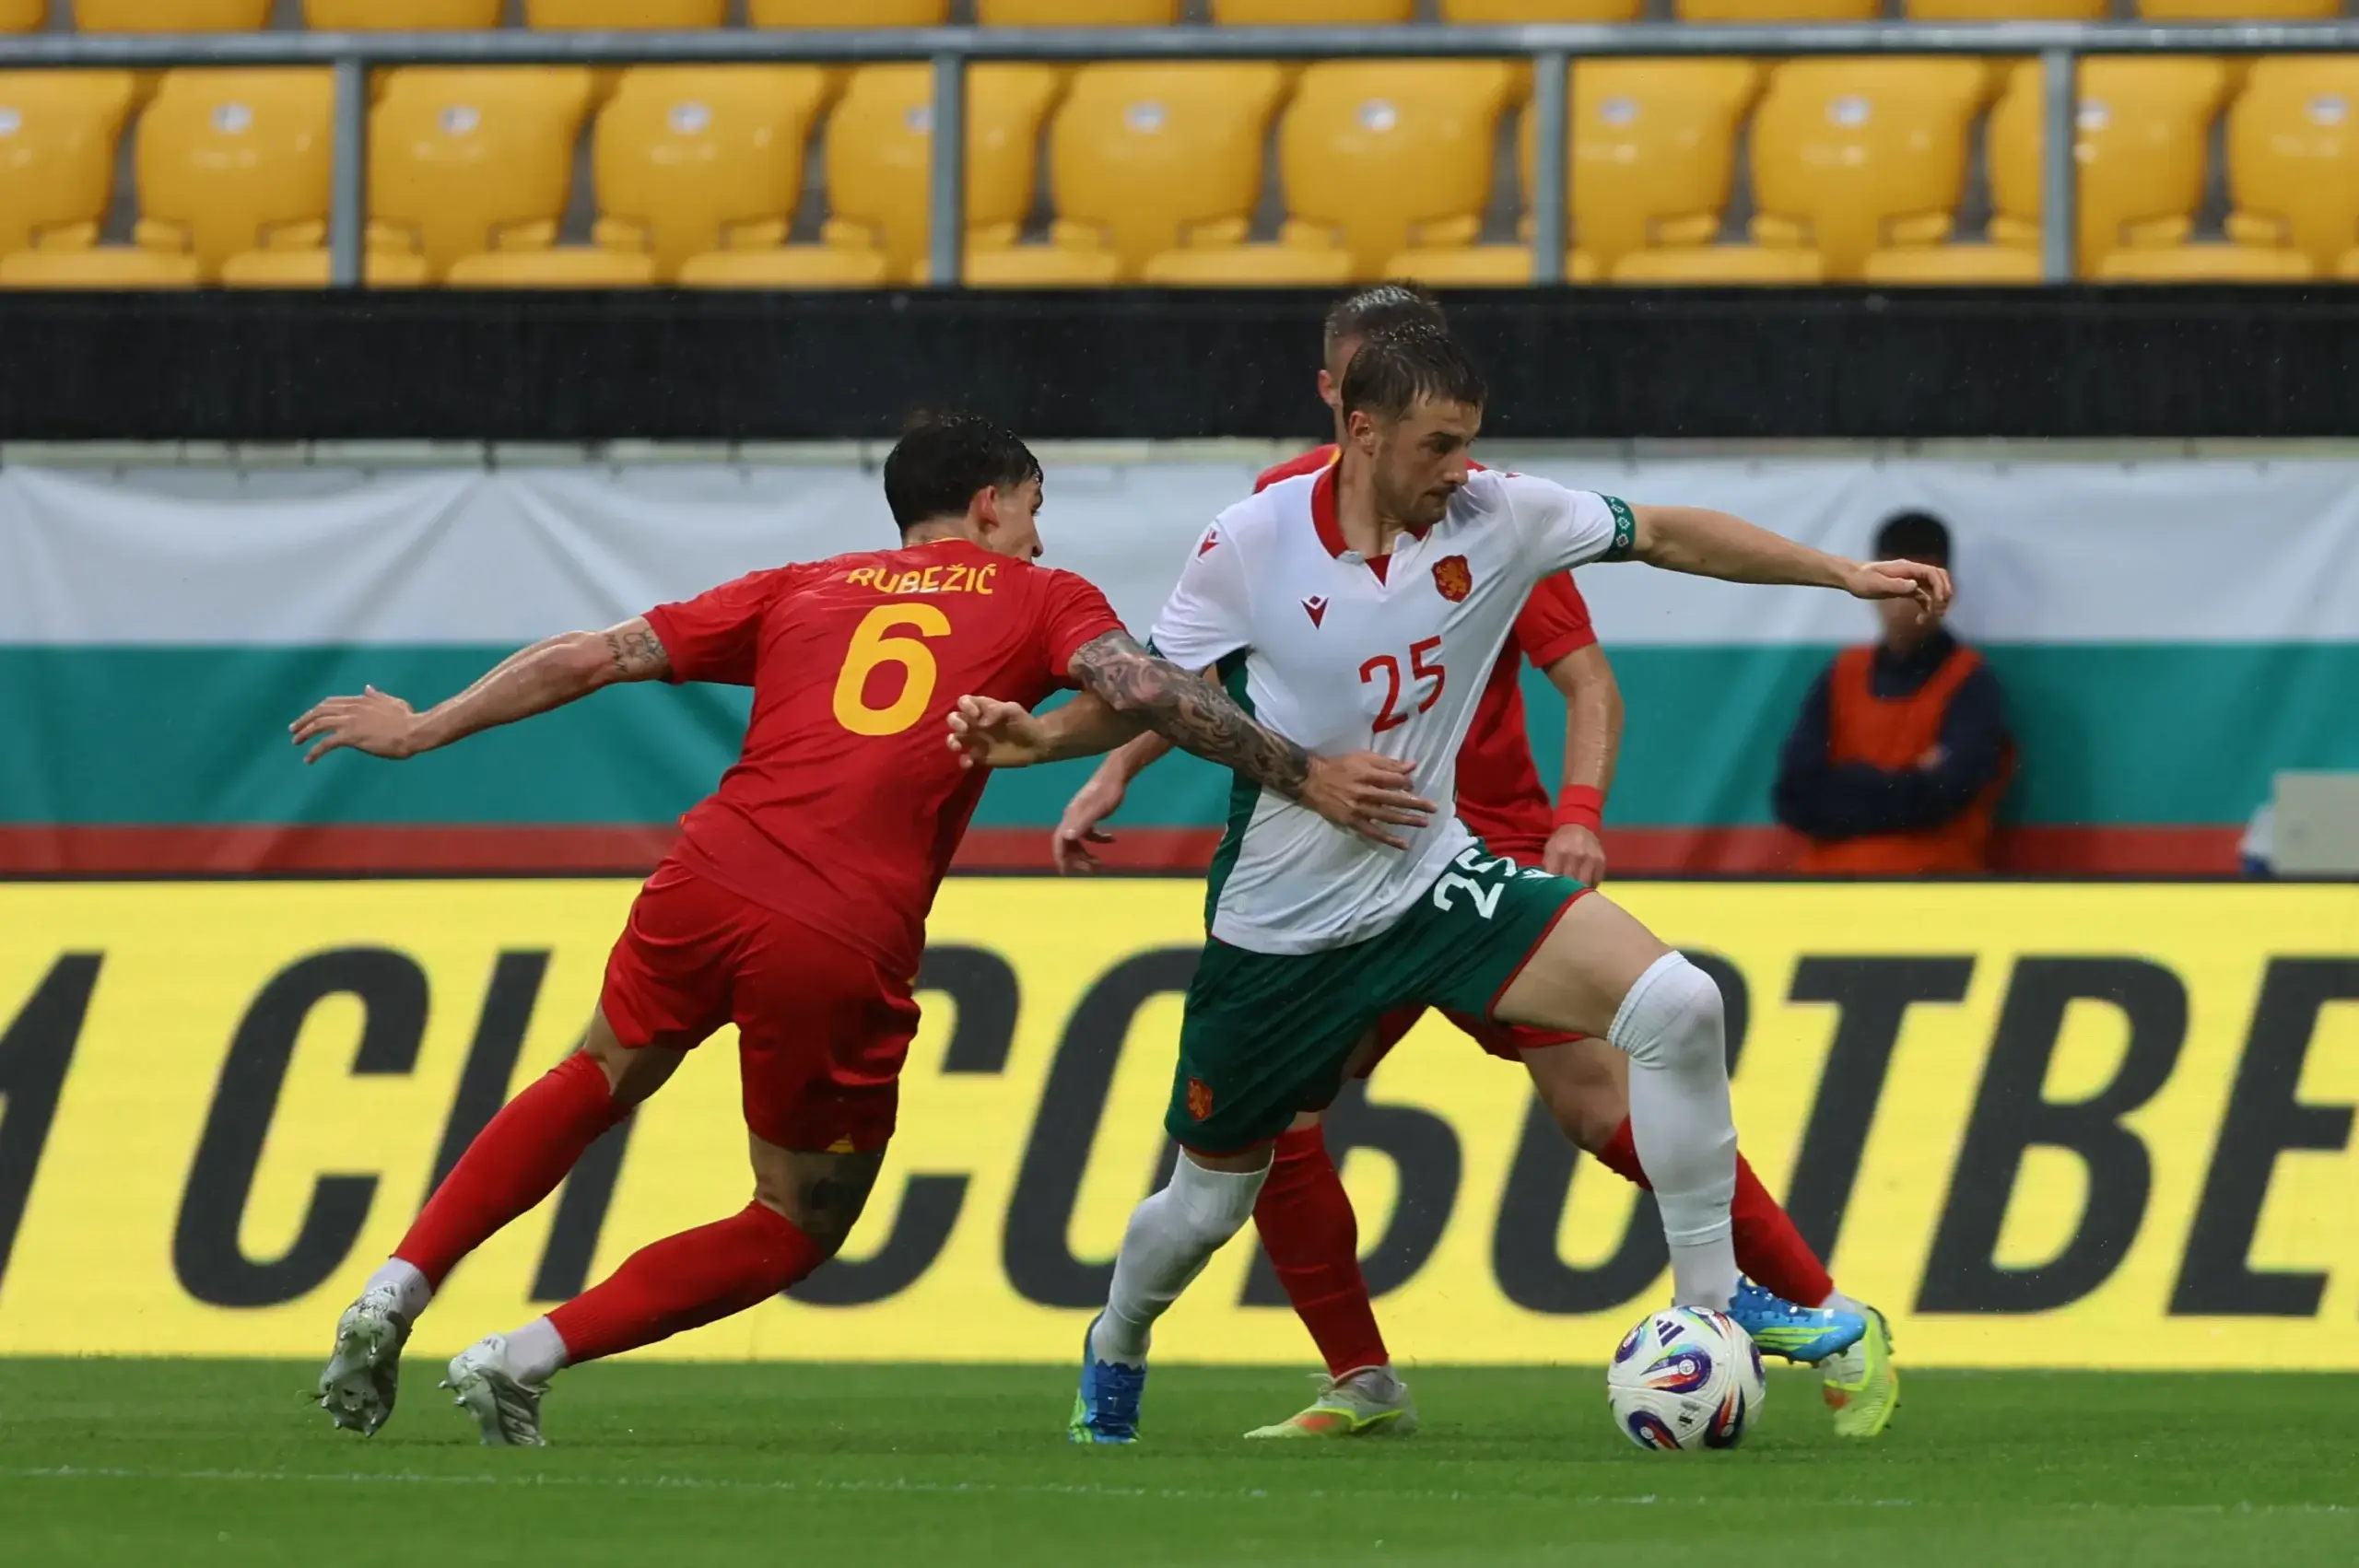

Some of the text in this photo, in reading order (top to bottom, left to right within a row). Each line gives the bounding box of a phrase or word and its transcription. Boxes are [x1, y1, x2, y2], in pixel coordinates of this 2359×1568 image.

[846, 563, 998, 594] RUBEŽIĆ
[832, 602, 952, 736] 6
[1358, 635, 1446, 734] 25
[1433, 848, 1517, 920] 25
